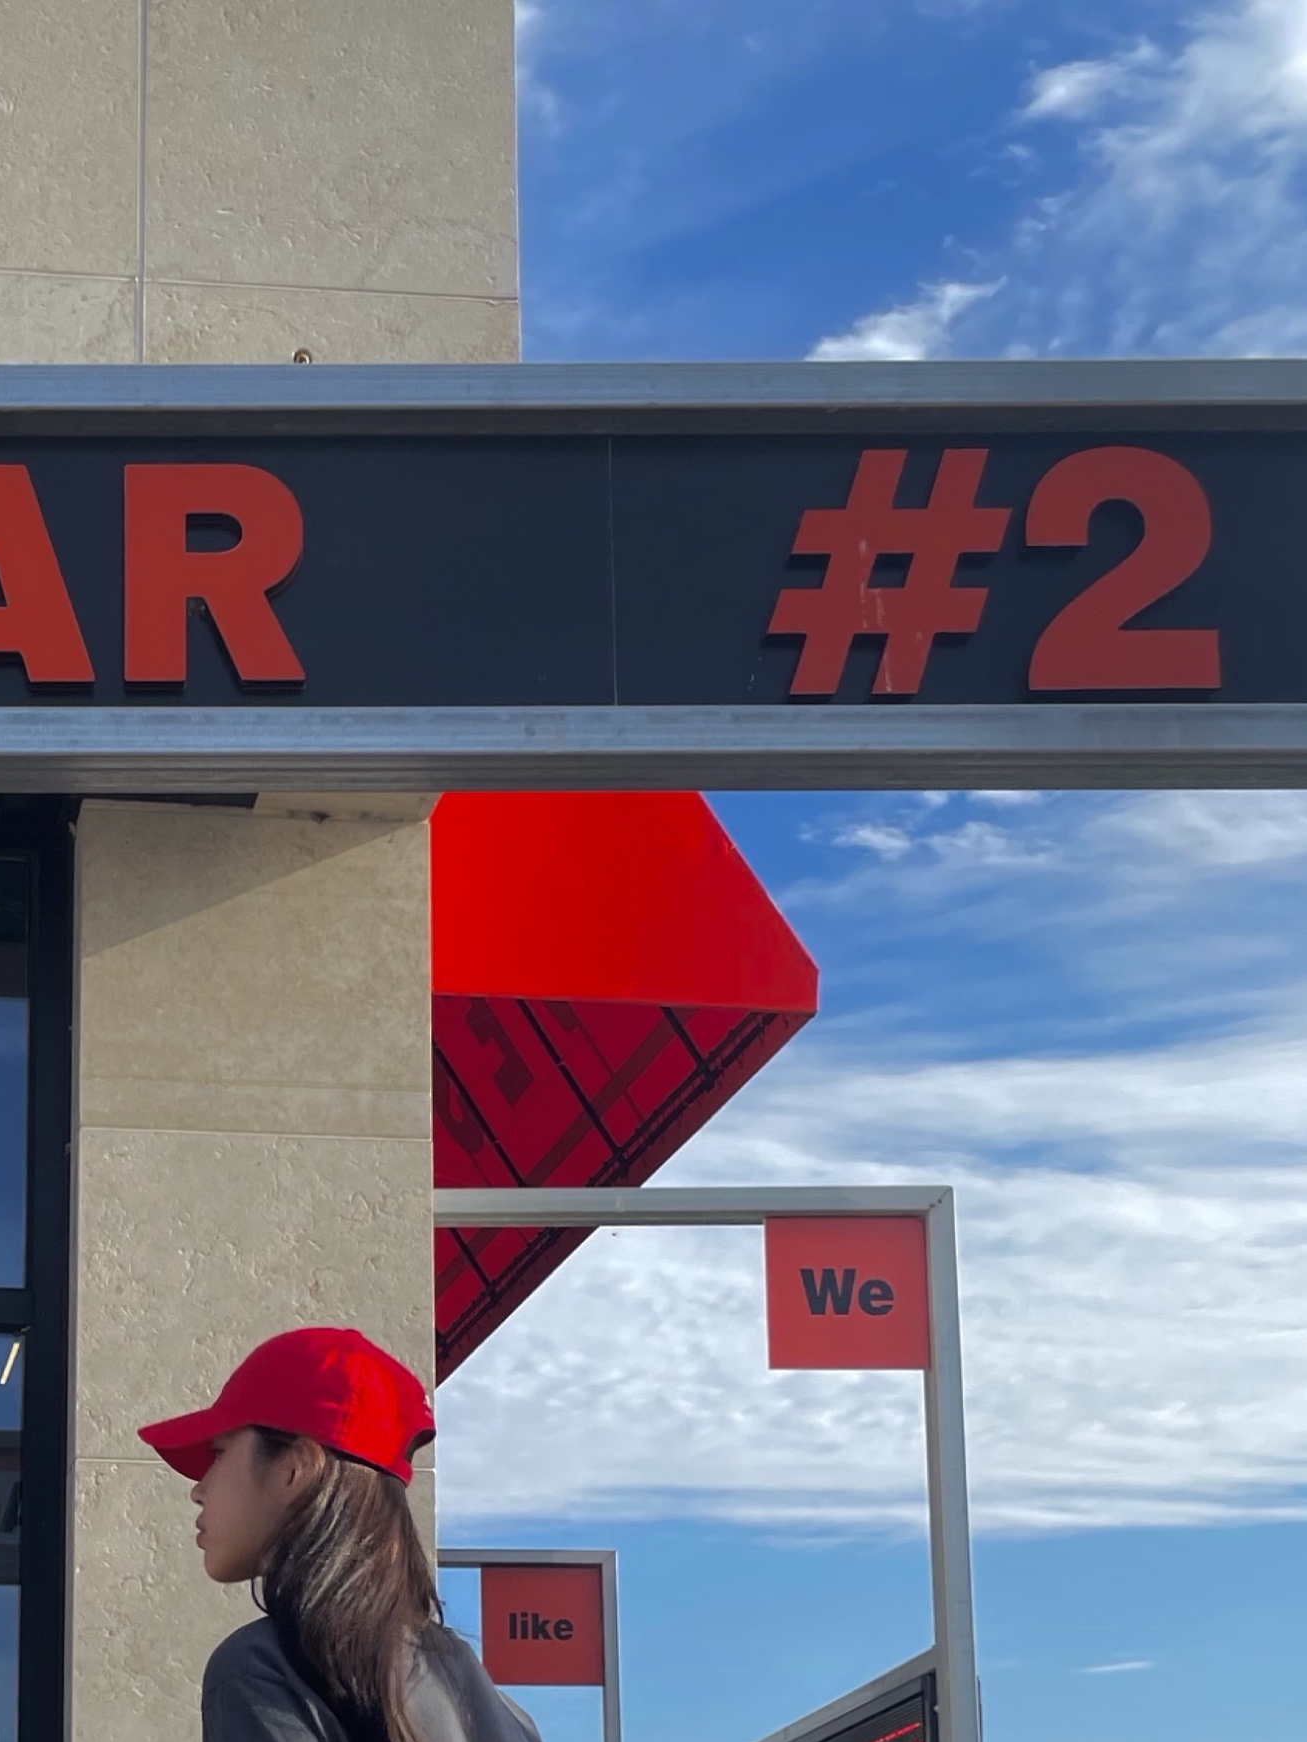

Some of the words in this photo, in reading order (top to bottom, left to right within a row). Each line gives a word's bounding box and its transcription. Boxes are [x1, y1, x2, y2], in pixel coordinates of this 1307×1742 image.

[766, 445, 1223, 697] #2
[800, 1267, 895, 1317] We
[507, 1611, 574, 1642] like
